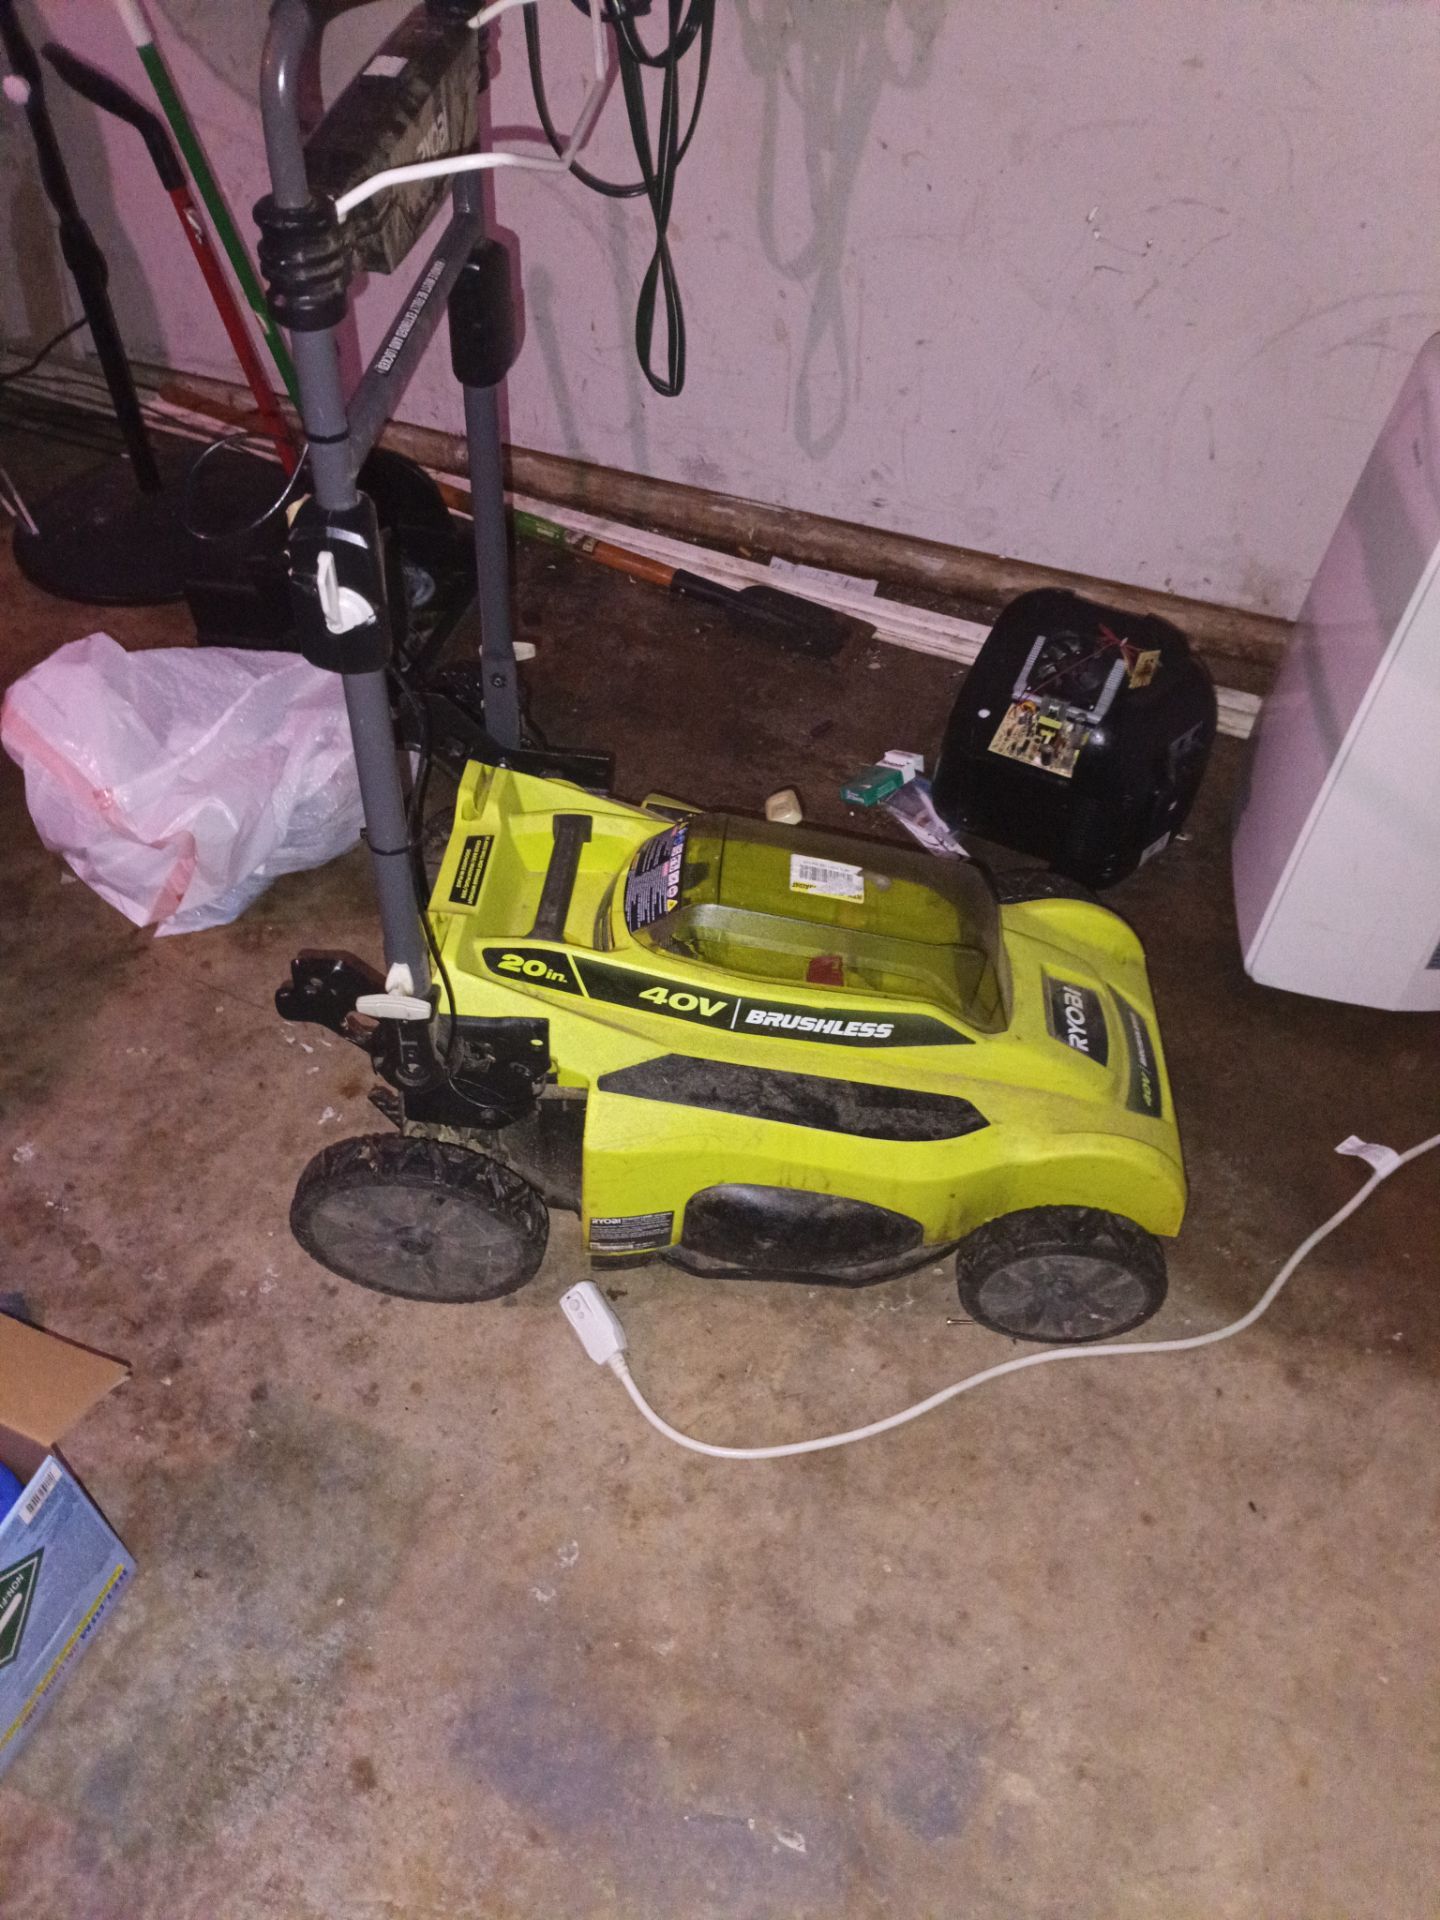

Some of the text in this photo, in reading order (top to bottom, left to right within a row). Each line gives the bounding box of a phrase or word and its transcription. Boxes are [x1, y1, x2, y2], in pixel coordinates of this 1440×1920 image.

[638, 986, 894, 1039] 40V BRUSHLESS
[1063, 985, 1089, 1052] RYOBI
[1140, 1070, 1154, 1108] 40V
[591, 1217, 622, 1226] RYOBI
